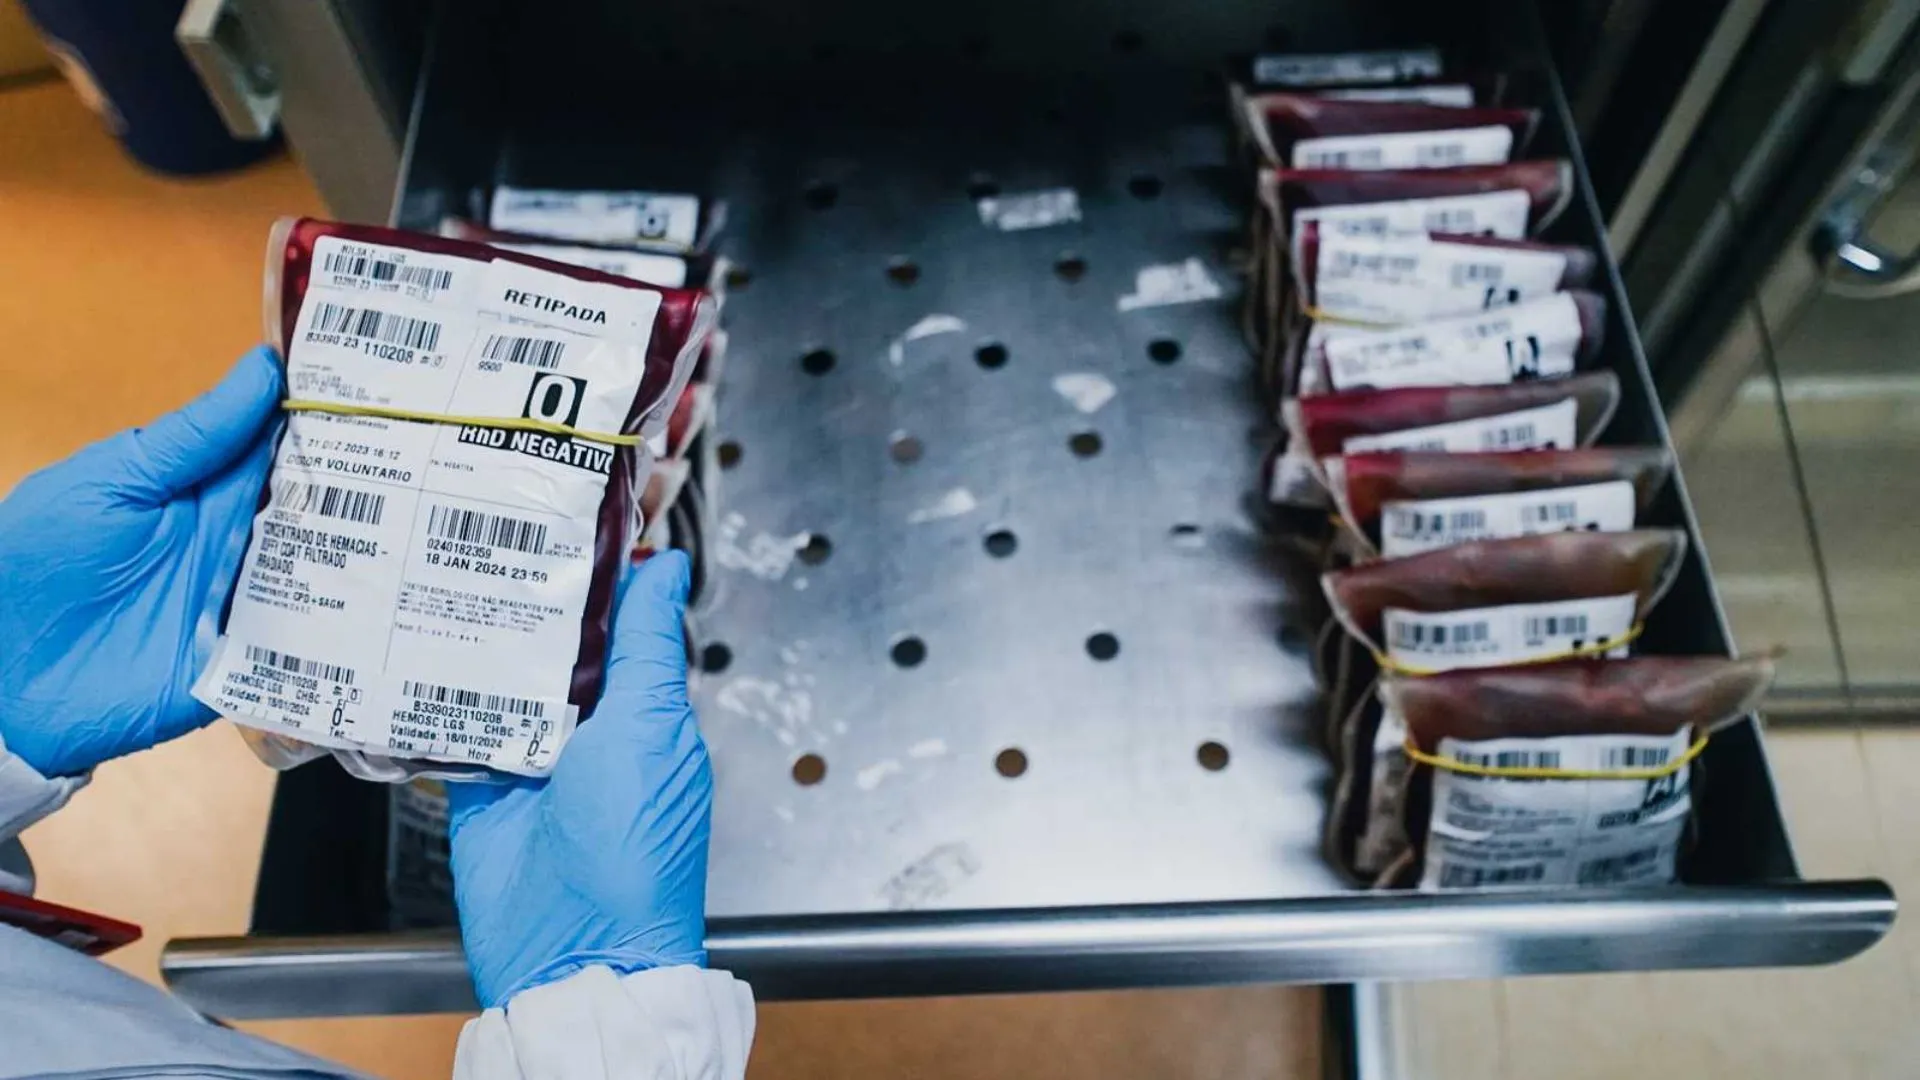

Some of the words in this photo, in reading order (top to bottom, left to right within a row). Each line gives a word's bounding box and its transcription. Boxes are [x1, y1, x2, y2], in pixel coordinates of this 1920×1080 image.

[504, 289, 607, 324] RETIPADA
[343, 337, 359, 349] 23
[364, 342, 414, 364] 110208
[344, 443, 369, 455] 2023
[327, 458, 412, 483] VOLUNTARIO
[316, 531, 328, 547] DE
[427, 537, 492, 560] 0240182359
[281, 541, 301, 558] COAT
[304, 546, 347, 569] FILTRADO
[425, 553, 440, 565] 18
[444, 555, 470, 571] JAN
[474, 561, 506, 577] 2024
[511, 567, 549, 584] 23:59
[319, 597, 345, 610] SAGM
[392, 710, 440, 728] HEMOSC
[443, 717, 465, 731] LGS
[484, 724, 515, 738] CHBC
[413, 700, 503, 724] B339023110208
[445, 732, 503, 748] 18/01/2024
